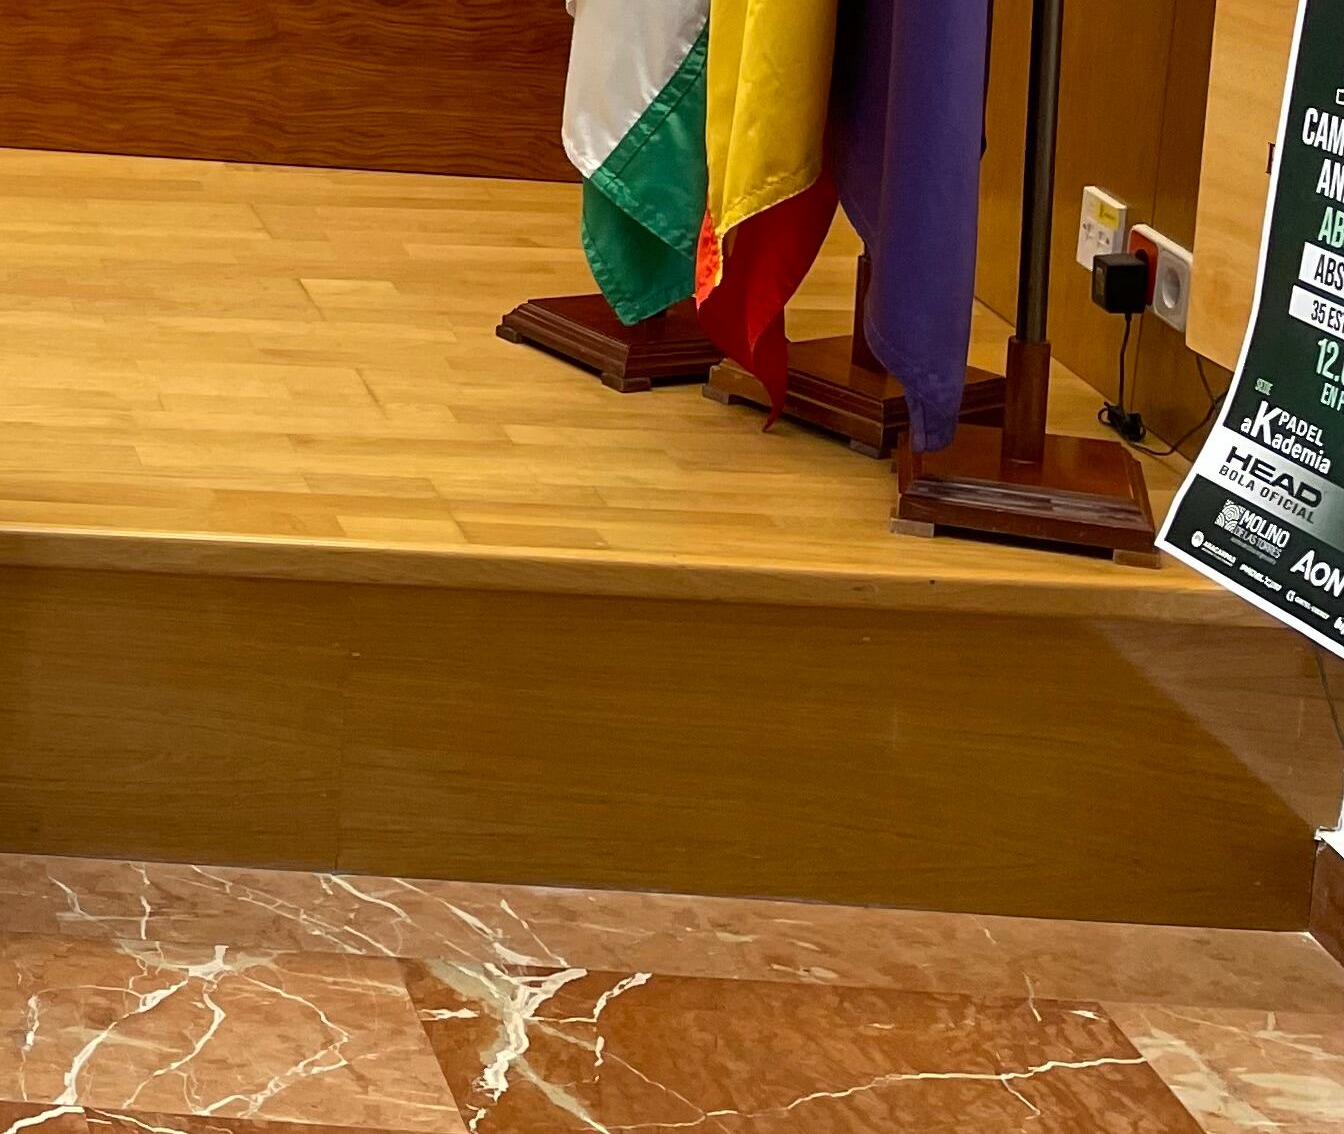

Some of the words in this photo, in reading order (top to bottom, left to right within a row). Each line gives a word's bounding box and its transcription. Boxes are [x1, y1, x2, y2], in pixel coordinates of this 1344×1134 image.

[1311, 299, 1327, 324] 35
[1320, 382, 1338, 408] EN
[1277, 410, 1324, 447] PADEL
[1218, 464, 1255, 492] BOLA
[1259, 486, 1315, 525] OFICIAL
[1225, 446, 1323, 507] HEAD
[1238, 509, 1291, 549] MOLINO
